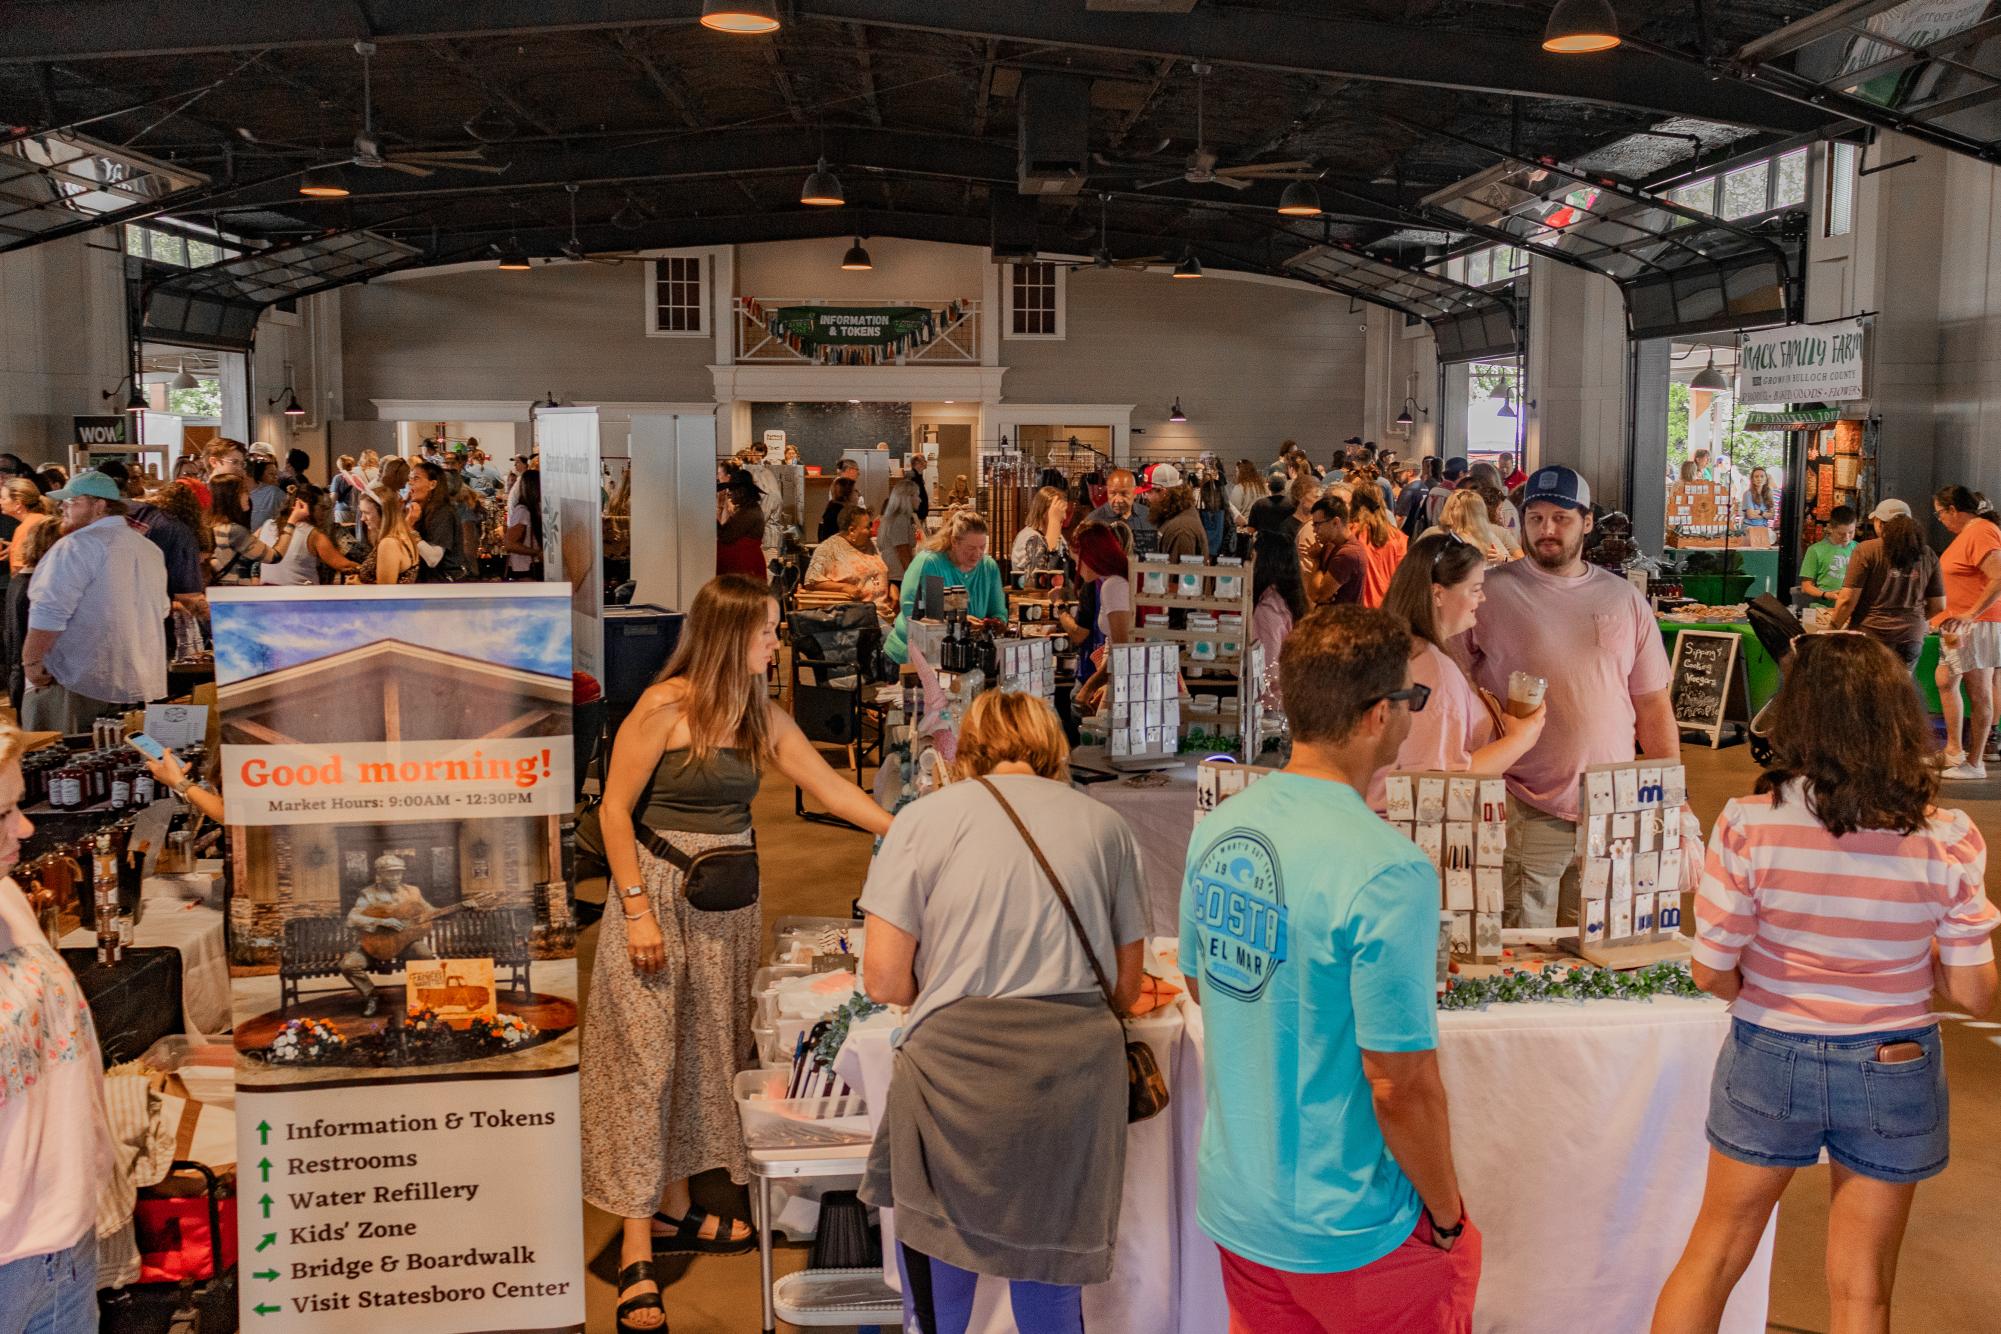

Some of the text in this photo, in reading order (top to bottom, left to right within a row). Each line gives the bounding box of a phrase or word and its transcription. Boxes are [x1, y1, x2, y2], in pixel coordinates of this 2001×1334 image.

[819, 314, 889, 326] INFORMATION
[828, 326, 881, 337] & TOKENS
[1779, 336, 1827, 369] FAMILY
[1832, 331, 1863, 365] FARM
[1829, 369, 1857, 380] COUNTY
[79, 426, 118, 443] WOW
[1684, 641, 1716, 661] Sipping
[240, 749, 551, 788] Good morning!
[268, 798, 327, 812] Market
[331, 798, 384, 810] Hours:
[389, 794, 450, 808] 9:00AM
[466, 792, 533, 806] 12:30PM
[1214, 861, 1228, 877] 19
[1193, 877, 1279, 954] COSTA
[1210, 937, 1228, 961] EL
[1236, 945, 1263, 977] MAR
[286, 1109, 556, 1141] Information & Tokens
[287, 1152, 418, 1176] Restrooms
[288, 1181, 479, 1210] Water Refillery
[289, 1221, 417, 1245] Kids' Zone
[290, 1246, 536, 1280] Bridge & Boardwalk
[291, 1281, 570, 1314] Visit Statesboro Center
